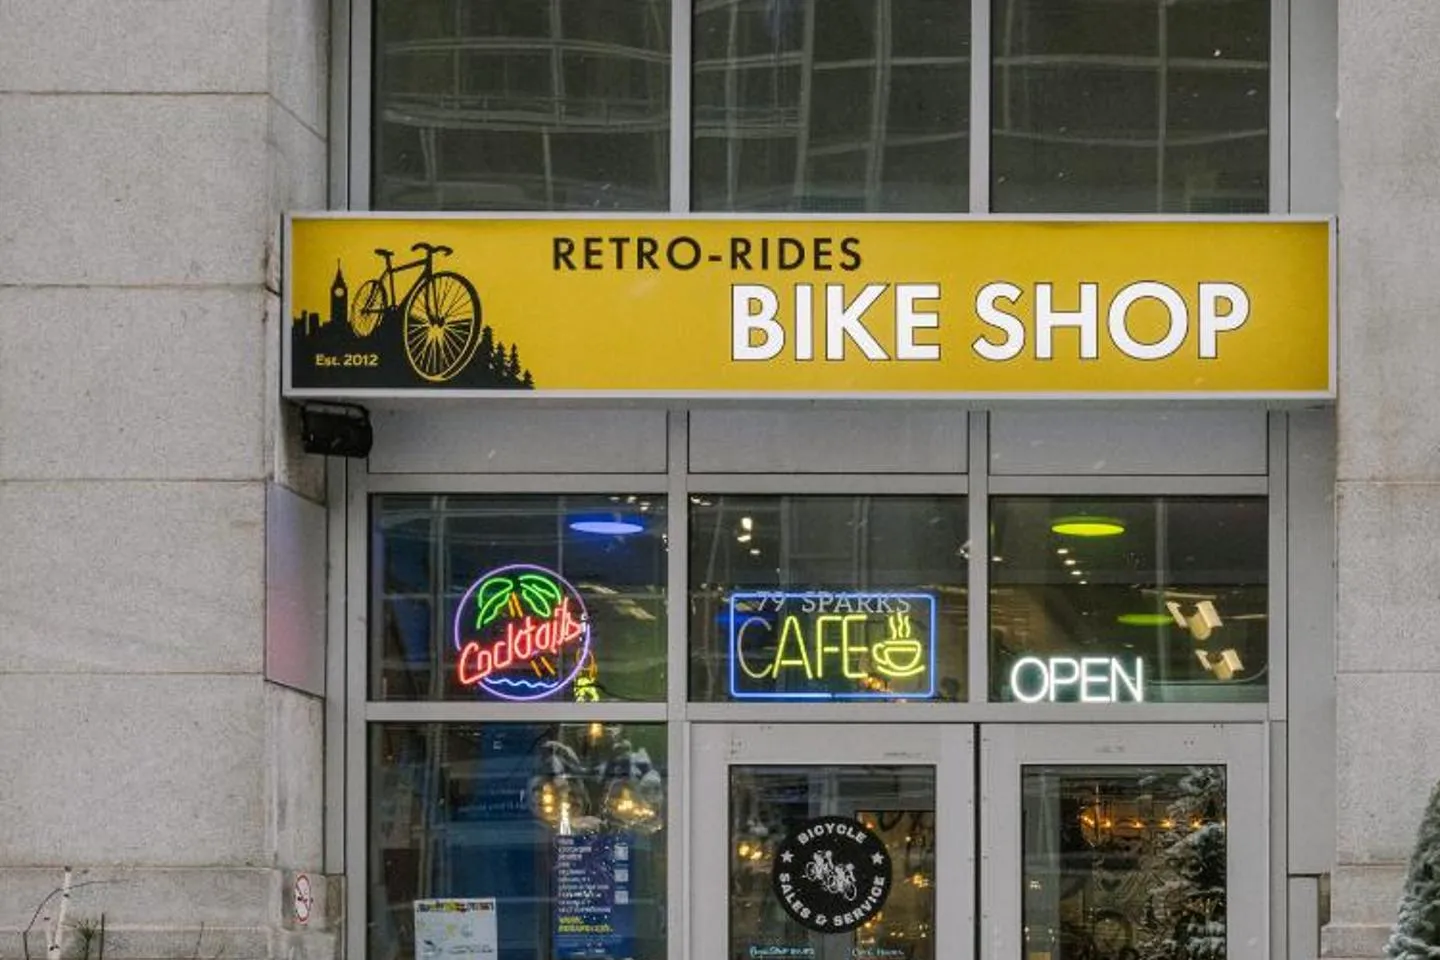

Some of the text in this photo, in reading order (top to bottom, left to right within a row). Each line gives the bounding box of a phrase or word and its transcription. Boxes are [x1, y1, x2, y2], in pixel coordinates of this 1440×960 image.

[552, 236, 863, 271] RETRO-RIDES
[730, 280, 1251, 362] BIKE SHOP
[315, 353, 379, 366] Est. 2012
[757, 590, 912, 614] 79 SPARKS
[459, 596, 583, 685] Cocktails
[736, 614, 870, 680] CAFE
[1010, 655, 1145, 703] OPEN
[798, 822, 868, 846] BICYCLE
[778, 872, 812, 920] SALES
[833, 875, 886, 928] SERVICE
